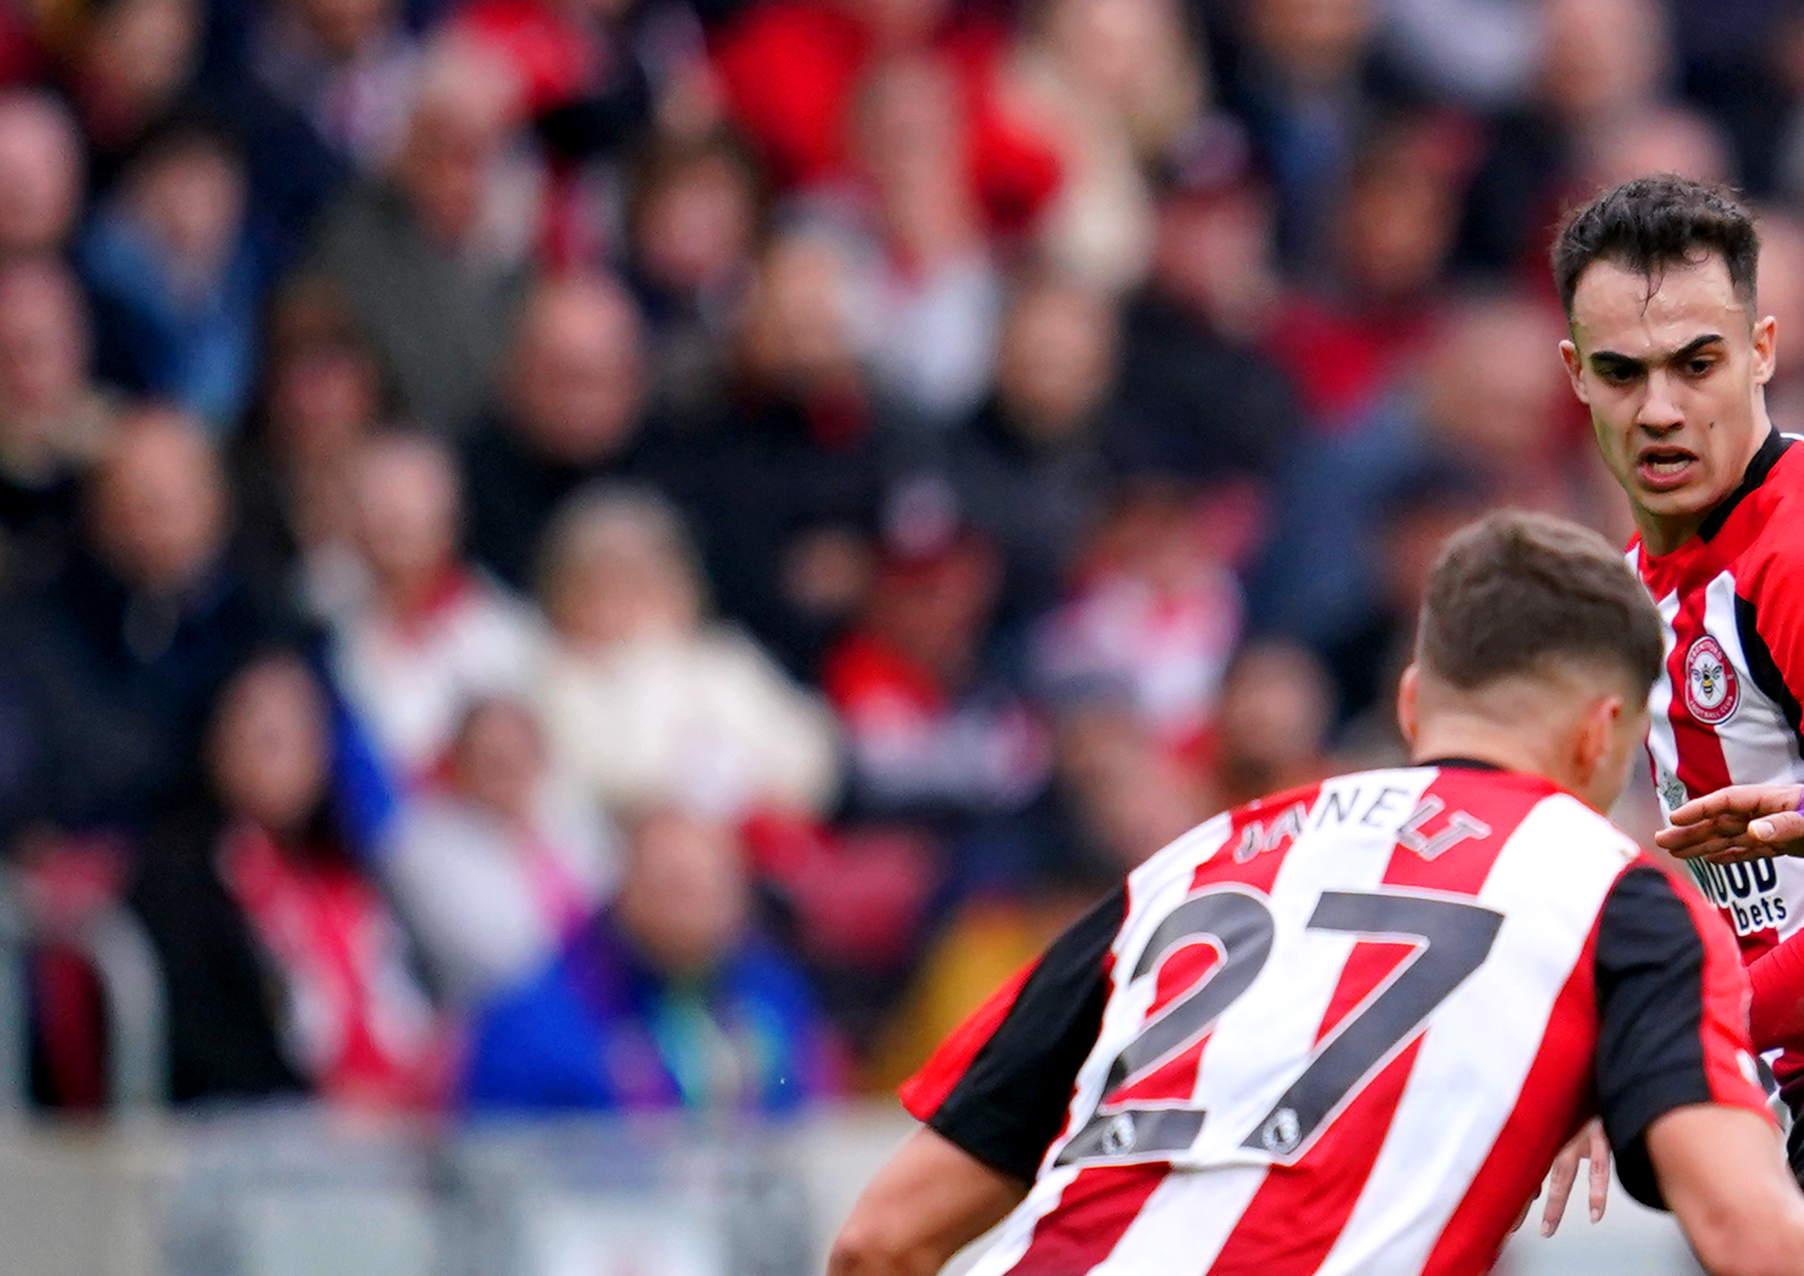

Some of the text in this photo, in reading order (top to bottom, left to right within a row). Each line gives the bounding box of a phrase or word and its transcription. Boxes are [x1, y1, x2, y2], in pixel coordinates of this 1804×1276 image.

[1233, 785, 1493, 862] JANELT
[1731, 896, 1787, 931] bets
[1053, 881, 1506, 1168] 27
